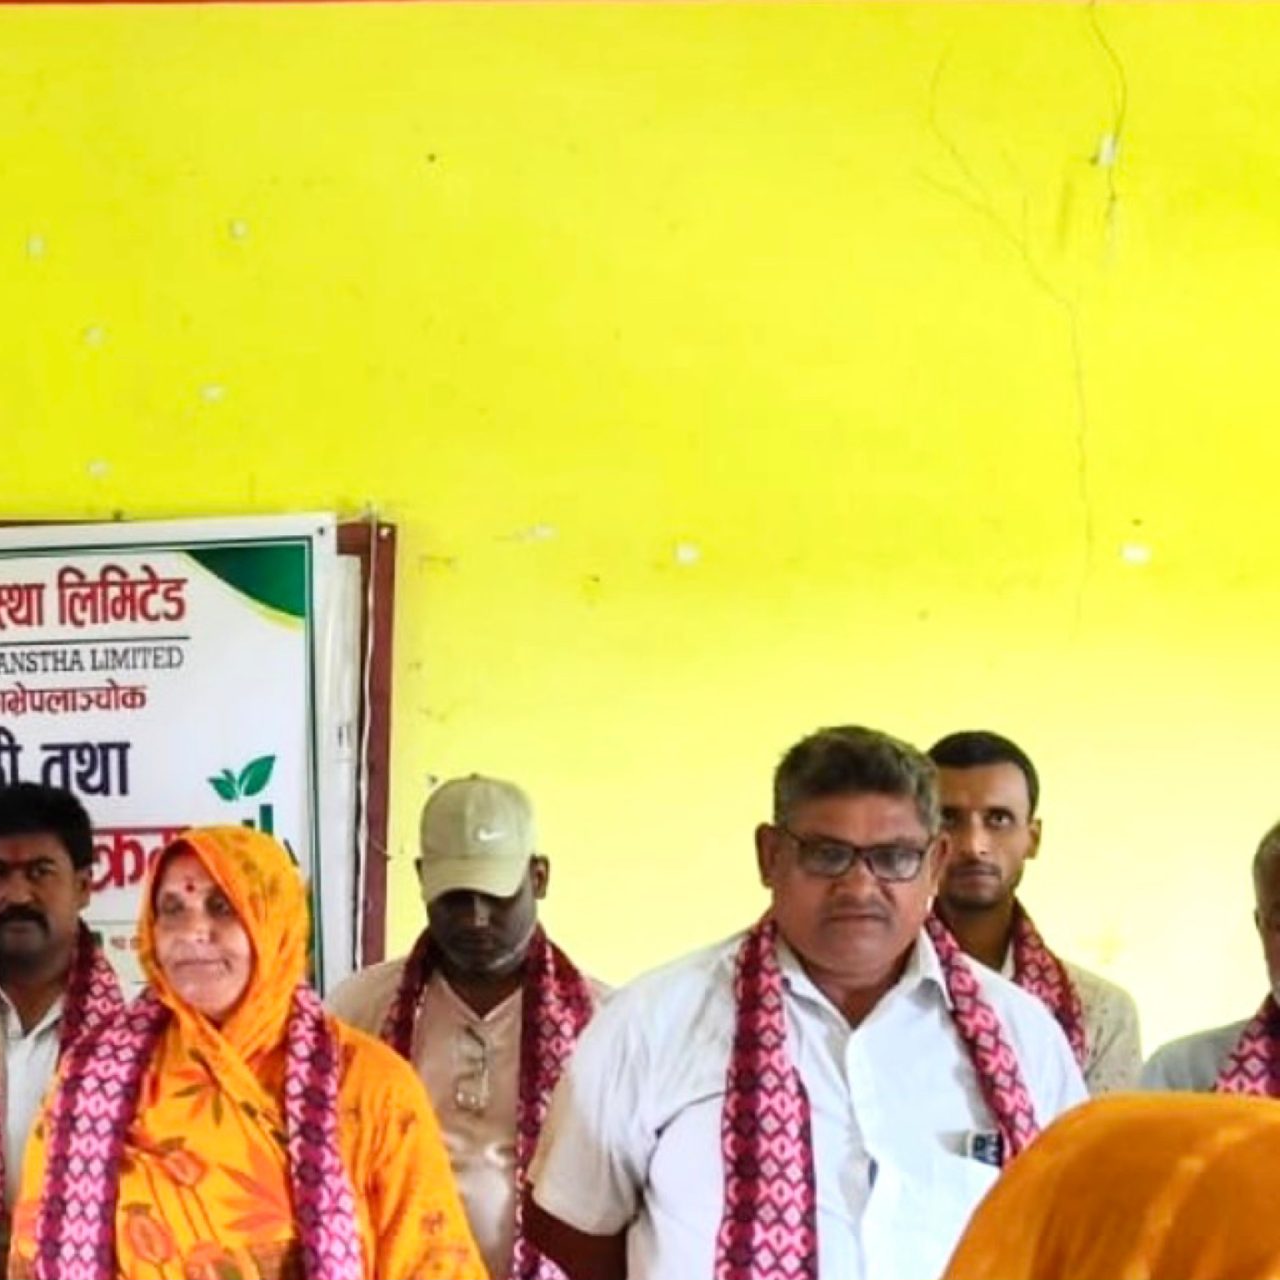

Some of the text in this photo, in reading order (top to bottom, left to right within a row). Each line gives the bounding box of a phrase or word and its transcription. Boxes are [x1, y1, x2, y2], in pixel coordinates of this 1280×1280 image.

[57, 564, 188, 628] लिमिटेड
[91, 645, 185, 671] LIMITED
[40, 741, 131, 796] तथा
